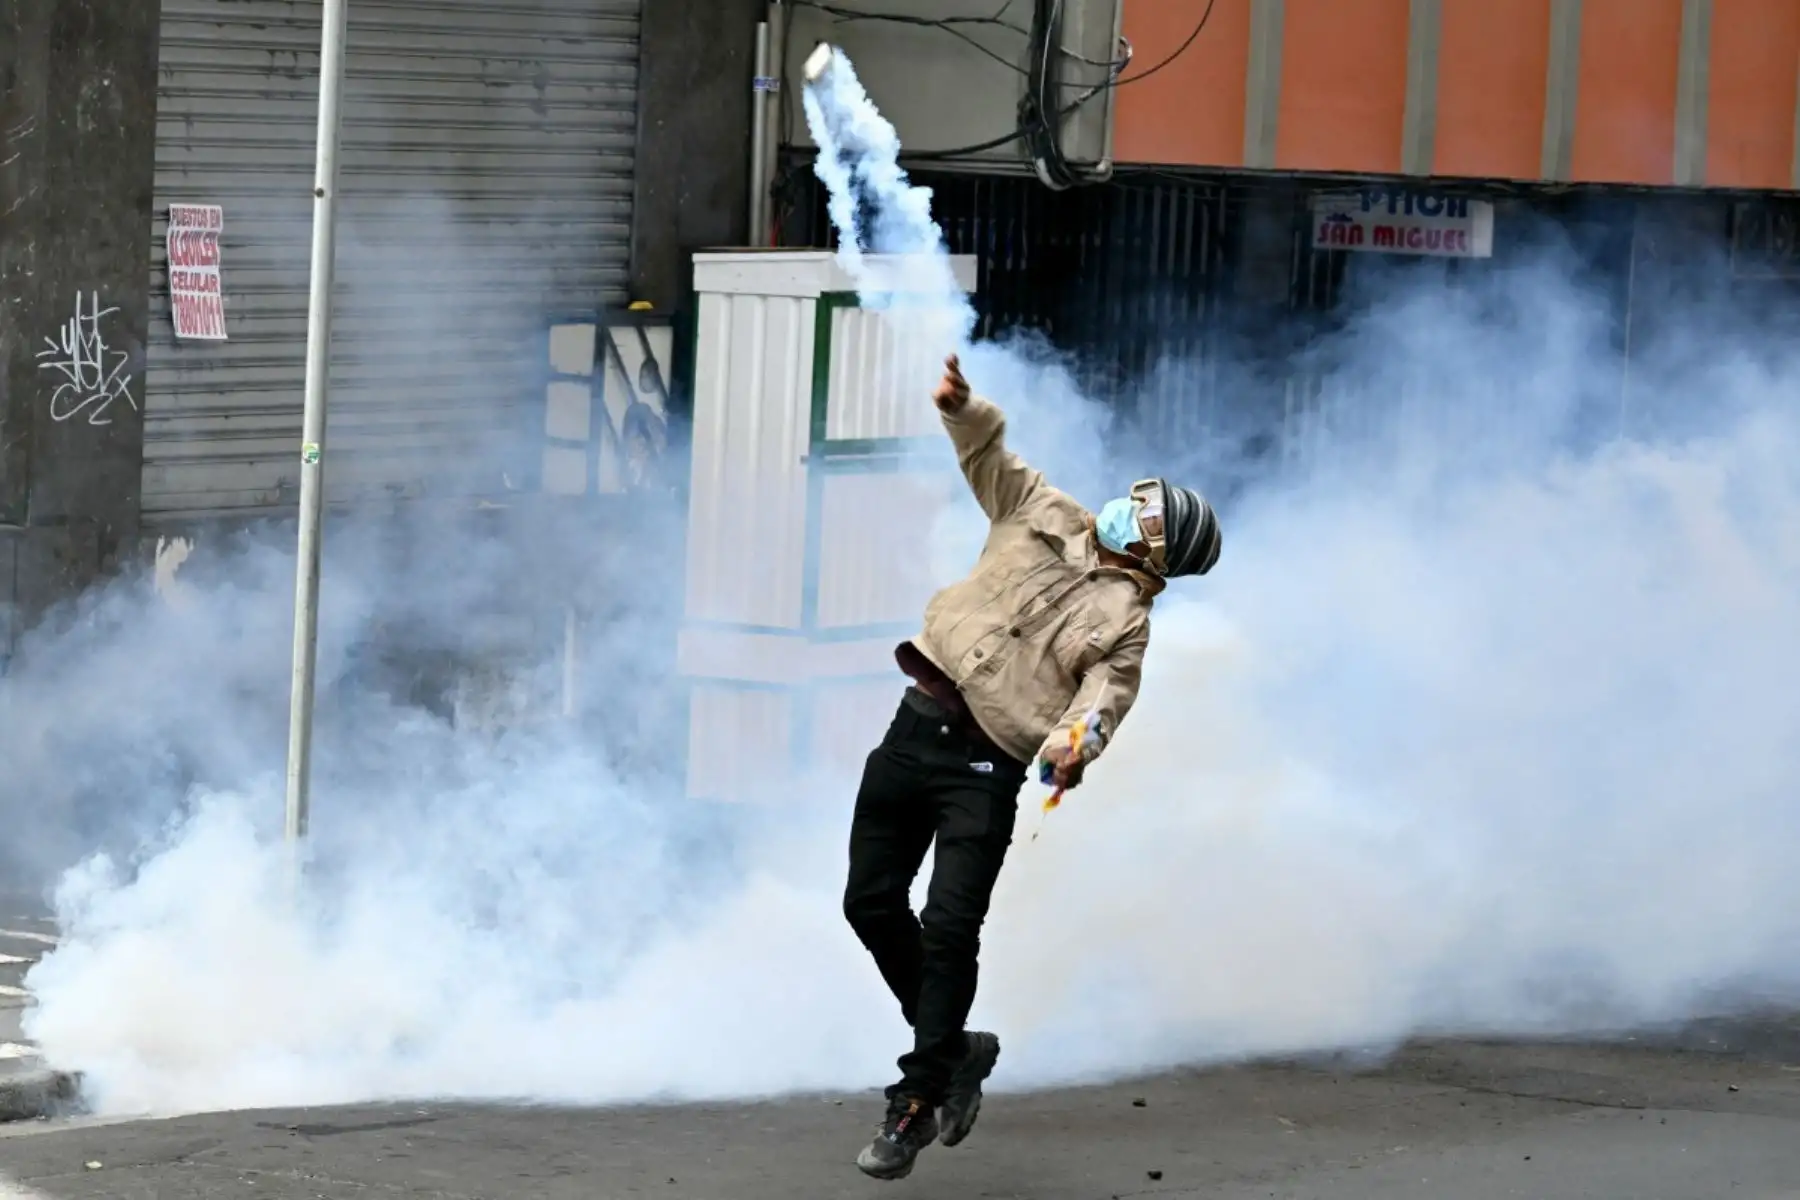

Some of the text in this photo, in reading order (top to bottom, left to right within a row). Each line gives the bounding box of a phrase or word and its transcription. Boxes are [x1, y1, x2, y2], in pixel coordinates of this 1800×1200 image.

[171, 208, 209, 228] PUESTOS
[1317, 222, 1467, 252] SAN MIGUEL
[172, 271, 218, 292] CELULAR
